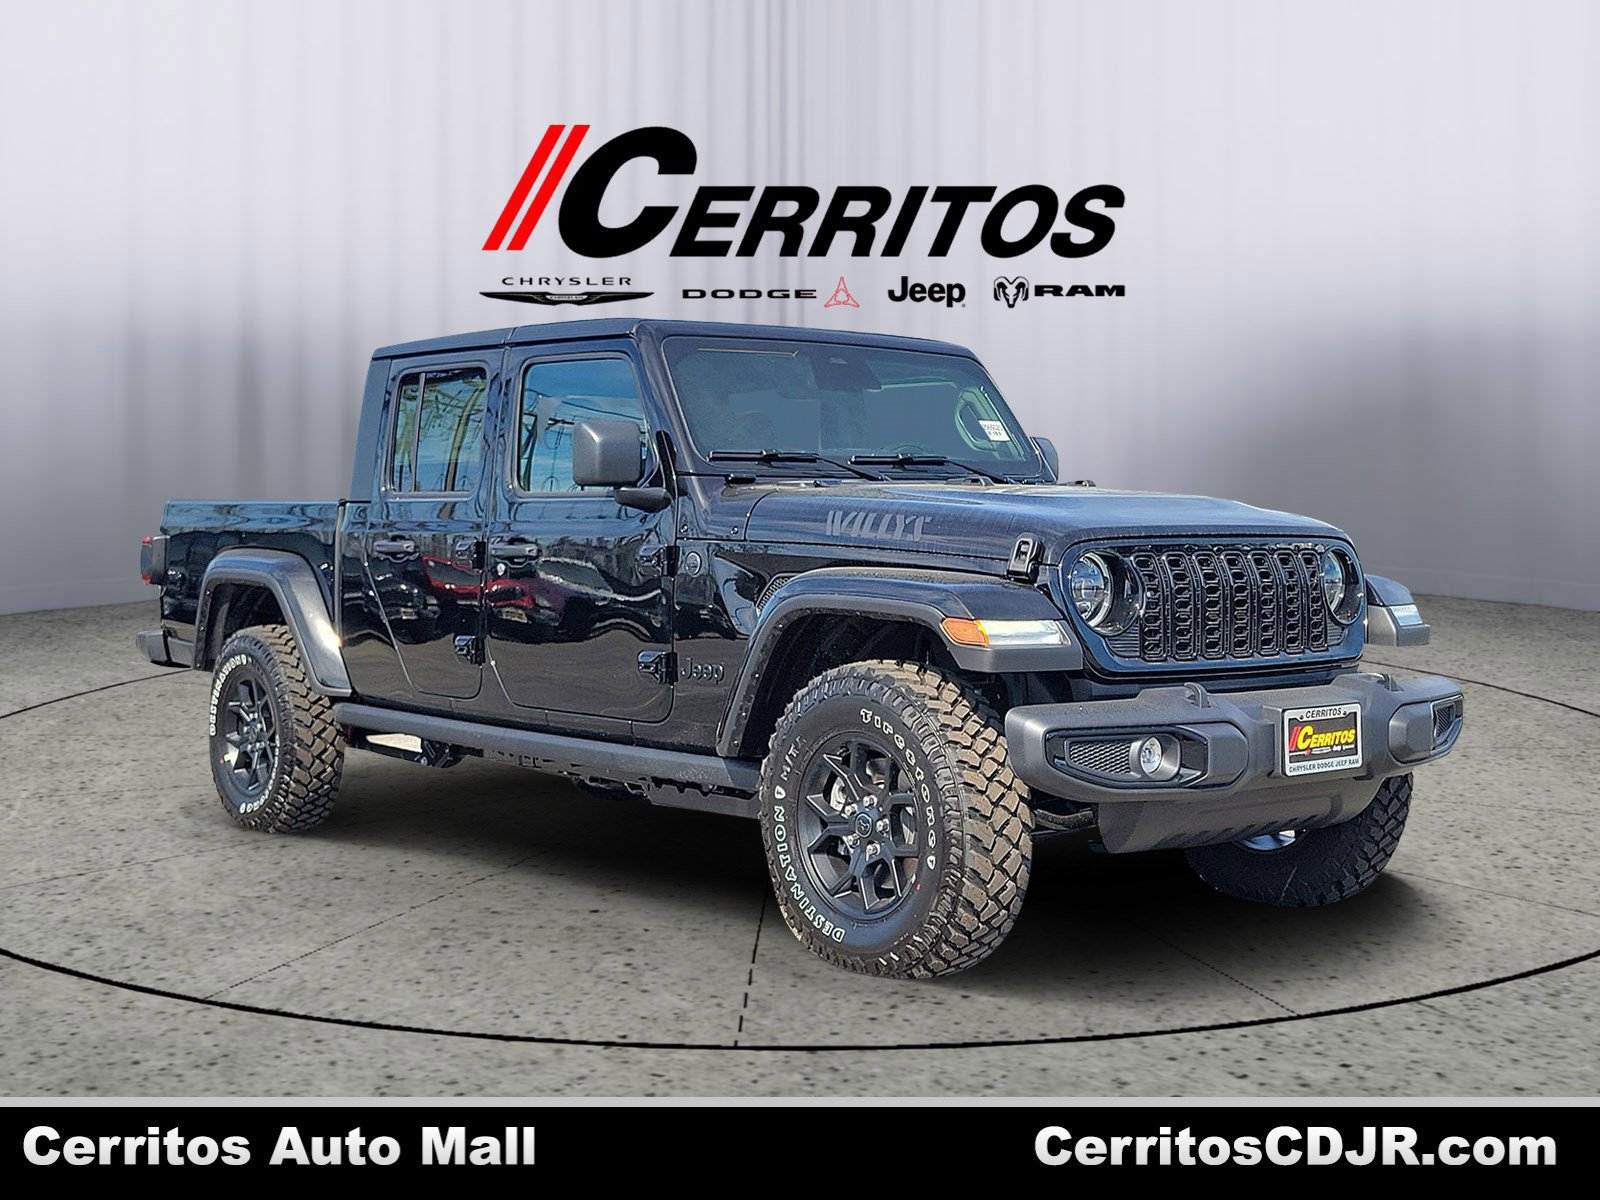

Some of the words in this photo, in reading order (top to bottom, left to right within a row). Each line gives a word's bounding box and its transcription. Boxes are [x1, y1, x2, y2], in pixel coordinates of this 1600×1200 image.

[681, 657, 725, 685] Jeep
[1305, 707, 1342, 719] CERRITOS
[1289, 764, 1317, 773] CHRYSLER
[1317, 761, 1335, 770] DODGE
[1335, 759, 1348, 768] JEEP
[1348, 758, 1360, 766] RAM
[773, 805, 847, 943] DESTINATION
